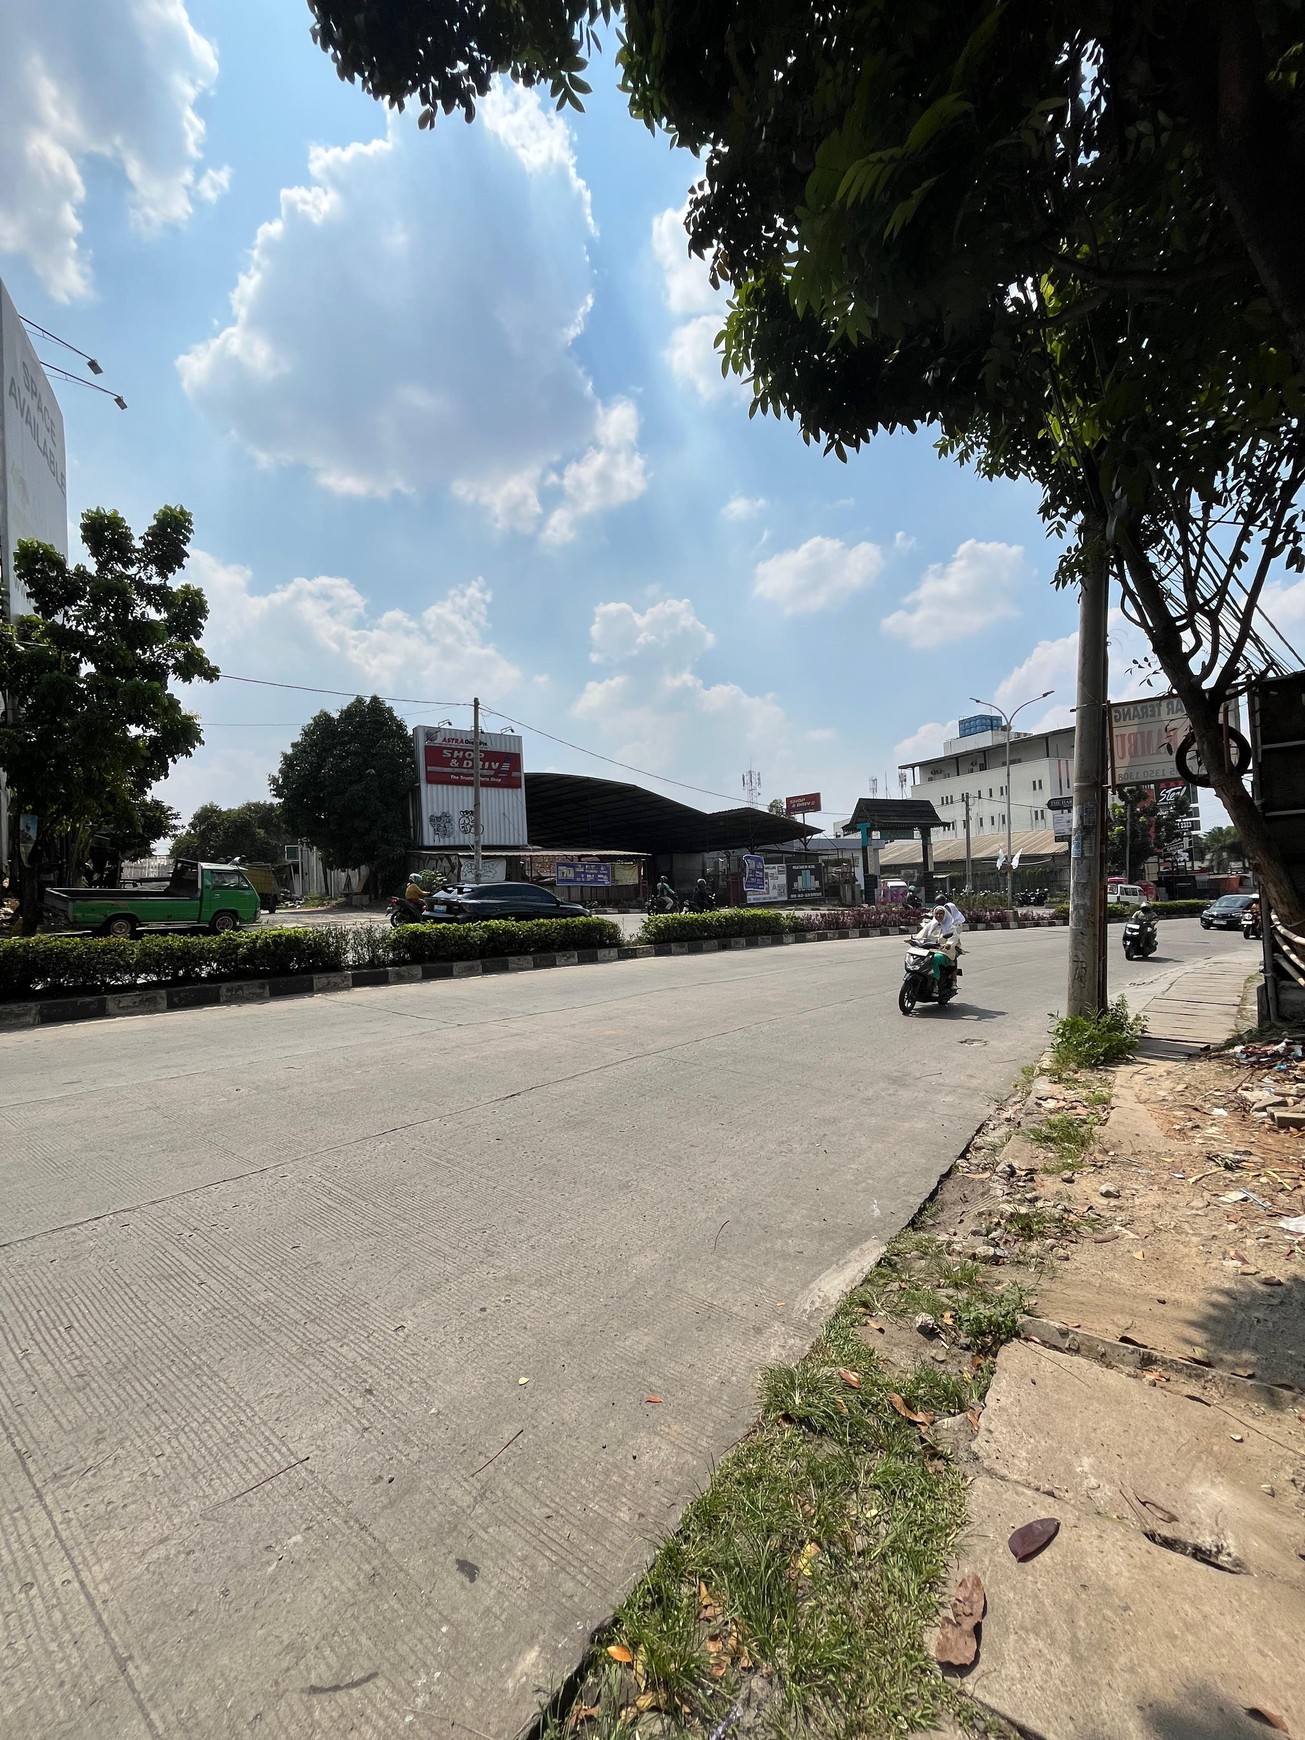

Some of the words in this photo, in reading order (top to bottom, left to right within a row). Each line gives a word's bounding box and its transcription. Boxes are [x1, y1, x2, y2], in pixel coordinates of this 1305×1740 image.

[22, 360, 56, 447] SPACE
[8, 375, 66, 498] AVAILABLE
[441, 737, 465, 745] ASTRA
[449, 759, 459, 768] &
